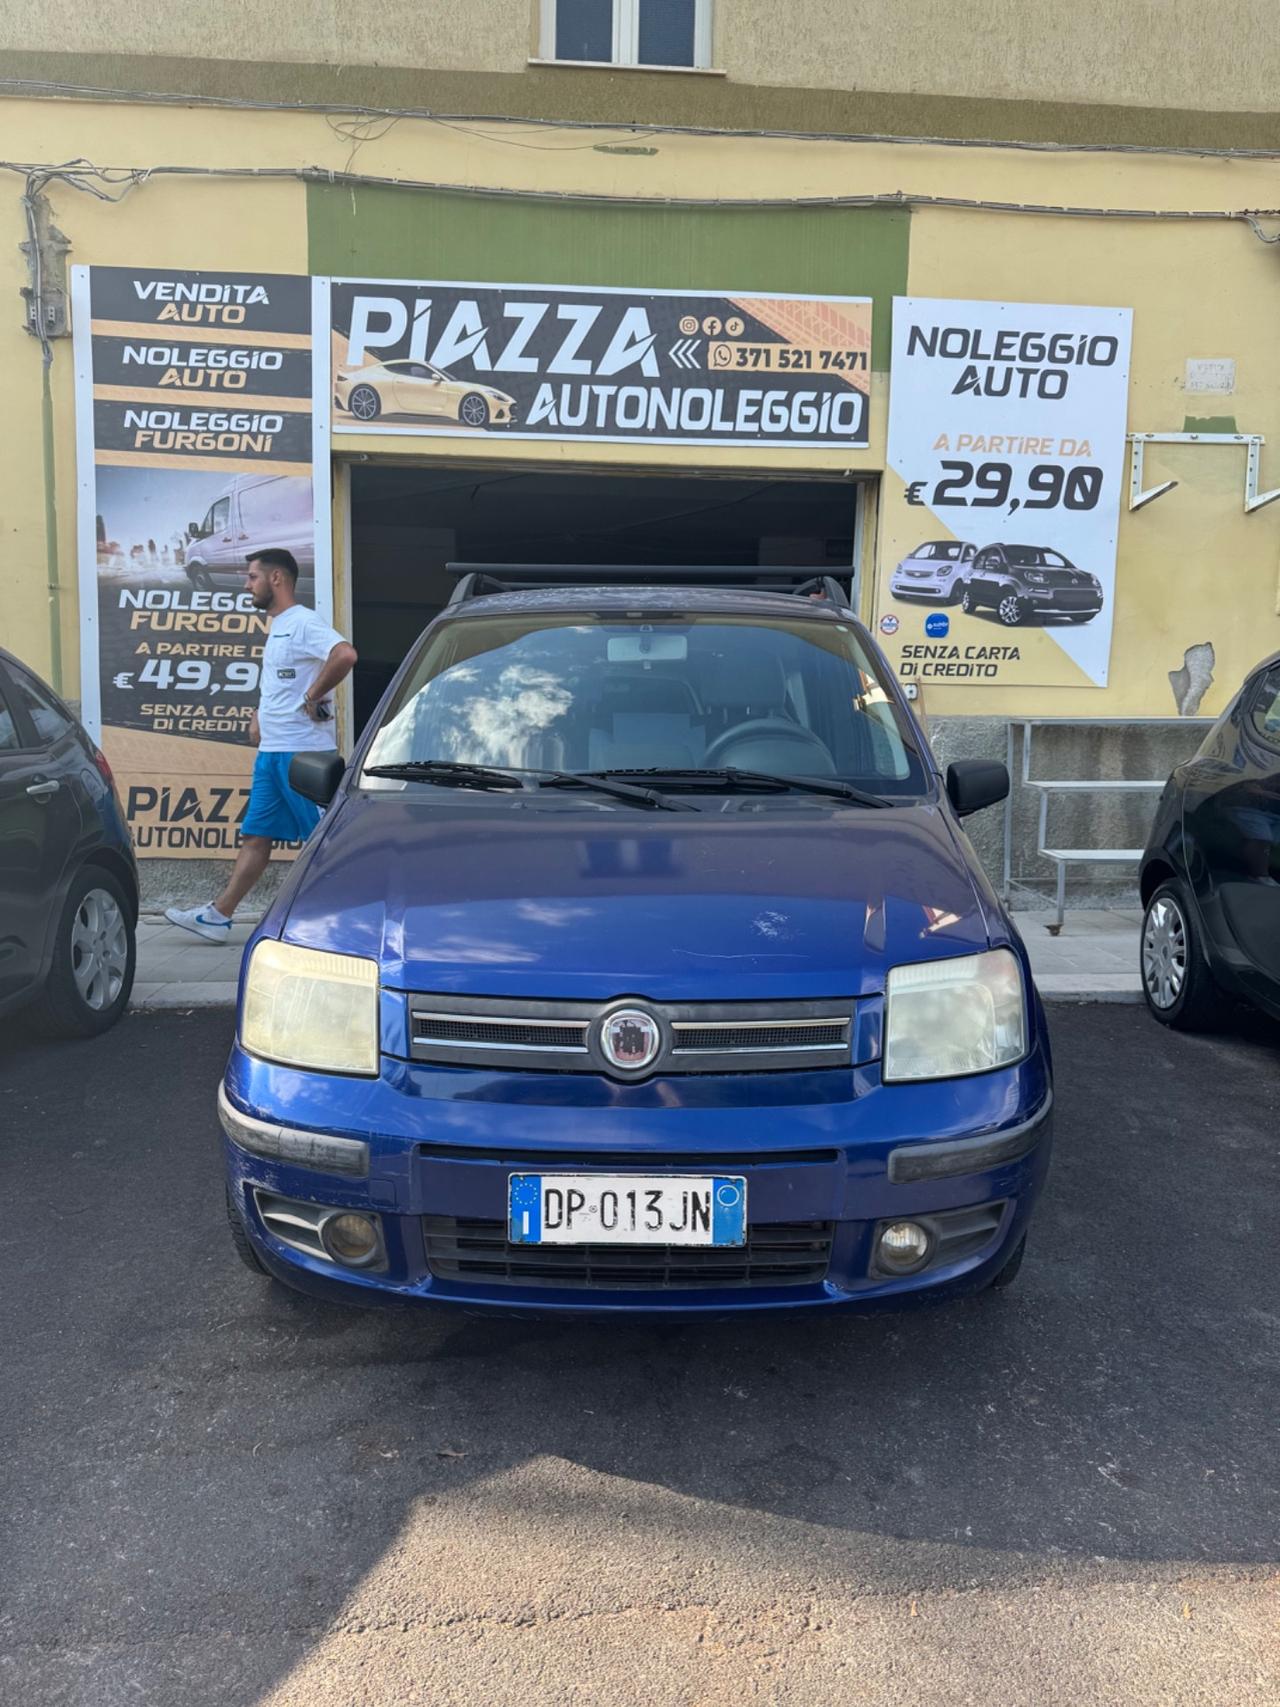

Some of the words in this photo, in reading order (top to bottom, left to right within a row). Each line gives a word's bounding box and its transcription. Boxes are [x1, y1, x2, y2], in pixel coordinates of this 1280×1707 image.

[157, 303, 246, 323] AUTO
[736, 347, 771, 369] 371
[778, 349, 812, 370] 521
[819, 351, 868, 371] 7471
[158, 367, 247, 388] AUTO
[951, 365, 1069, 400] AUTO
[933, 433, 949, 451] A
[1058, 438, 1092, 457] DA
[119, 589, 266, 613] NOLEGG
[130, 610, 272, 634] FURGON
[135, 641, 151, 654] A
[251, 646, 265, 658] D
[901, 645, 960, 659] SENZA
[965, 646, 1020, 660] CARTA
[138, 659, 261, 695] 49,9
[140, 704, 208, 717] SENZA
[212, 706, 256, 718] CAR
[178, 719, 250, 732] CREDIT
[544, 1188, 585, 1230] DP
